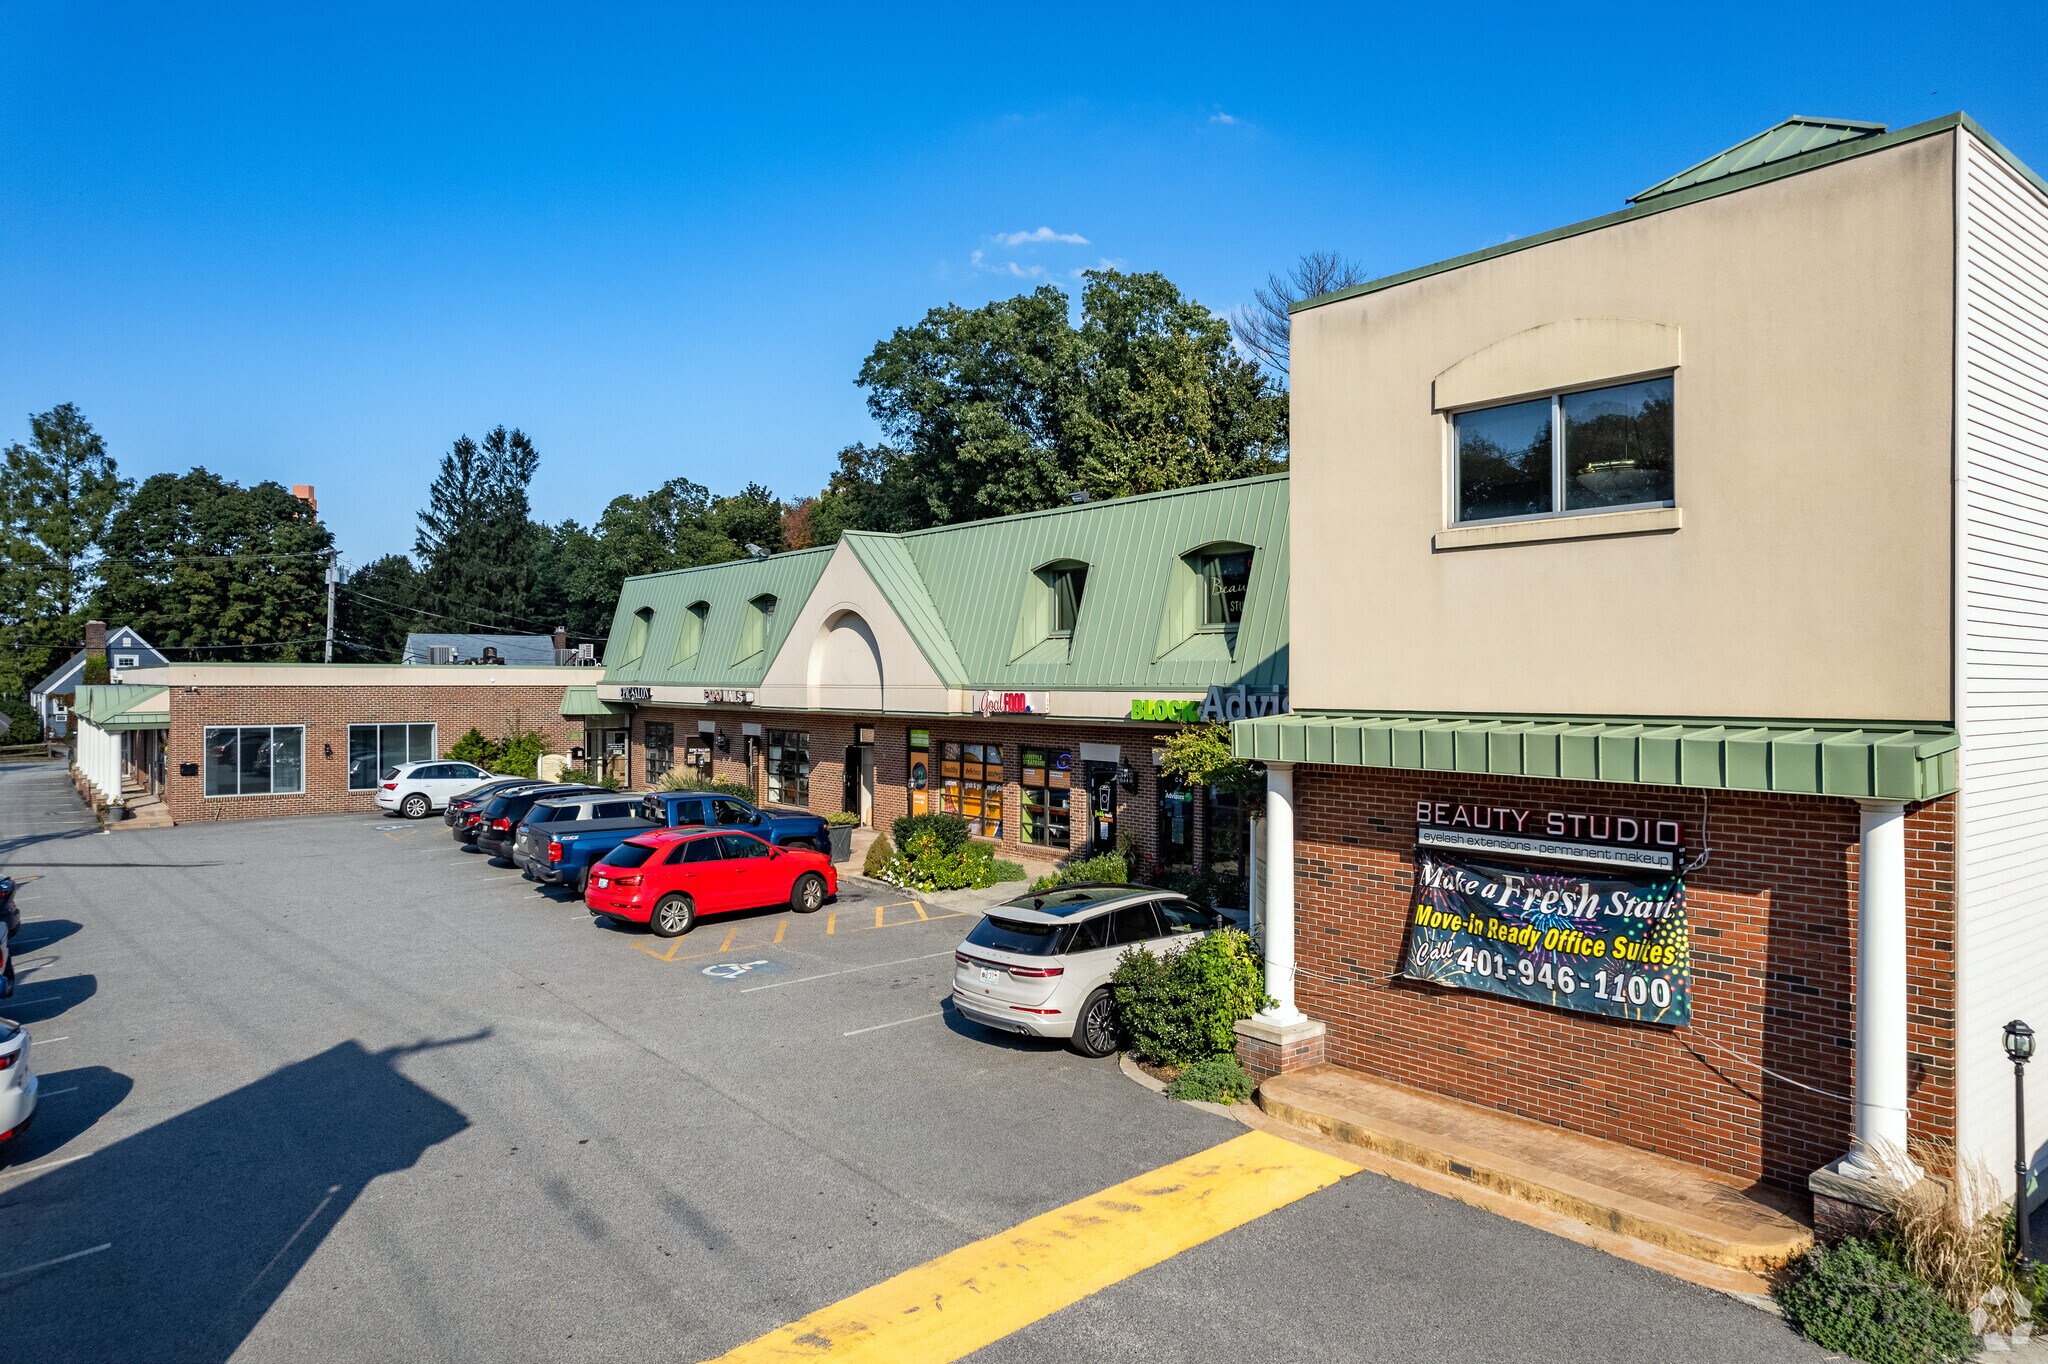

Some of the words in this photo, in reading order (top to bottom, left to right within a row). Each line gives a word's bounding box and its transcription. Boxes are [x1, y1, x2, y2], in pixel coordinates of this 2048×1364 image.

[1131, 699, 1198, 723] BLOCK
[1416, 801, 1529, 832] BEAUTY
[1546, 812, 1679, 845] STUDIO
[1423, 832, 1465, 845] eyelash
[1466, 837, 1531, 852] extensions
[1539, 843, 1611, 860] permanent
[1614, 851, 1669, 867] makeup
[1419, 862, 1480, 896] Make
[1480, 882, 1499, 899] a
[1493, 874, 1600, 919] Fresh
[1603, 890, 1676, 919] Start
[1414, 904, 1485, 936] Move-in
[1486, 917, 1542, 953] Ready
[1543, 927, 1606, 958] Office
[1611, 935, 1677, 966] Suites
[1416, 940, 1454, 967] Call
